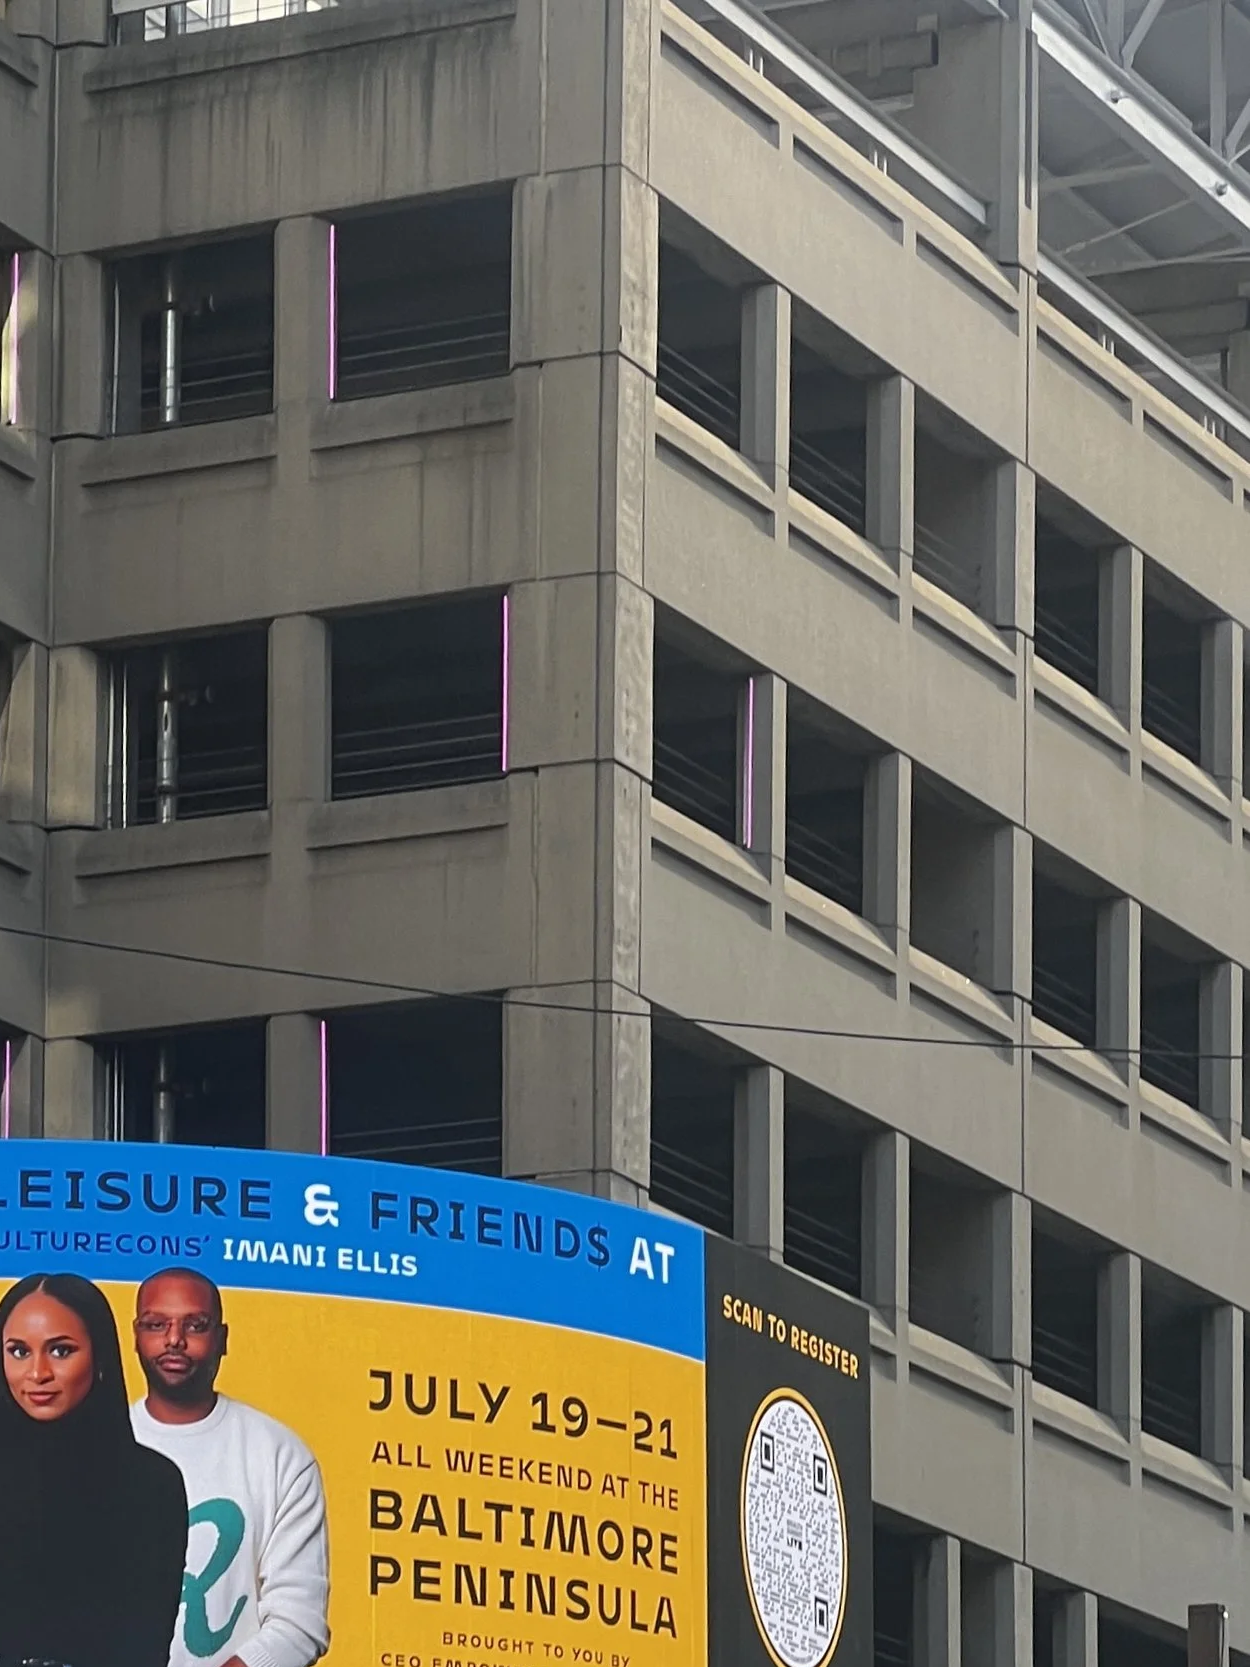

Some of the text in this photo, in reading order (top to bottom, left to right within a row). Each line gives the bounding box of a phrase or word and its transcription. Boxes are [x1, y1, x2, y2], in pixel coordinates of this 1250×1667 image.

[223, 1238, 326, 1268] IMANI
[337, 1248, 418, 1277] ELLIS
[304, 1183, 339, 1228] &
[629, 1236, 675, 1285] AT
[723, 1294, 859, 1379] SCAN TO REGISTER
[369, 1369, 510, 1422] JULY
[372, 1441, 679, 1512] ALL WEEKEND AT THE
[370, 1487, 679, 1576] BALTIMORE
[370, 1554, 679, 1639] PENINSULA
[442, 1631, 534, 1657] BROUGHT
[542, 1640, 564, 1658] TO
[572, 1645, 604, 1666] YOU
